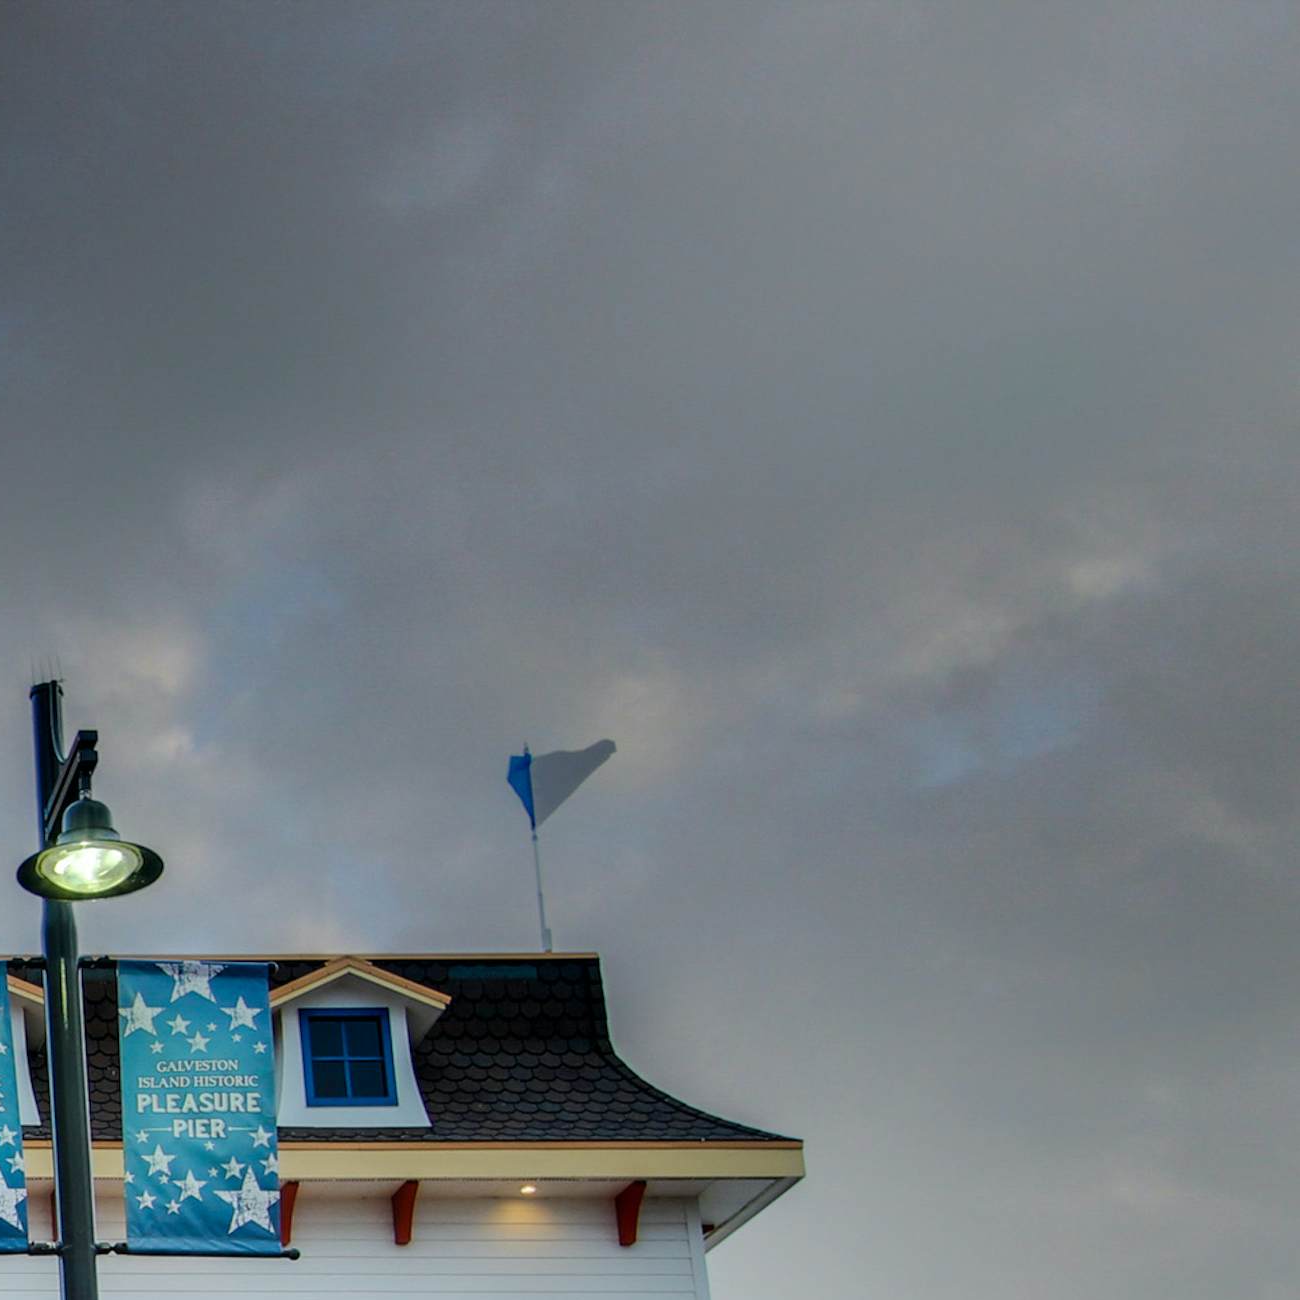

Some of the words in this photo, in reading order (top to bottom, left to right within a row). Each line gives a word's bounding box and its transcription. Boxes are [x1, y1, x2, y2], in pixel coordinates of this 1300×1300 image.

[156, 1059, 239, 1073] GALVESTON
[137, 1076, 192, 1089] ISLAND
[193, 1075, 259, 1088] HISTORIC
[136, 1092, 262, 1114] PLEASURE
[172, 1118, 227, 1140] PIER
